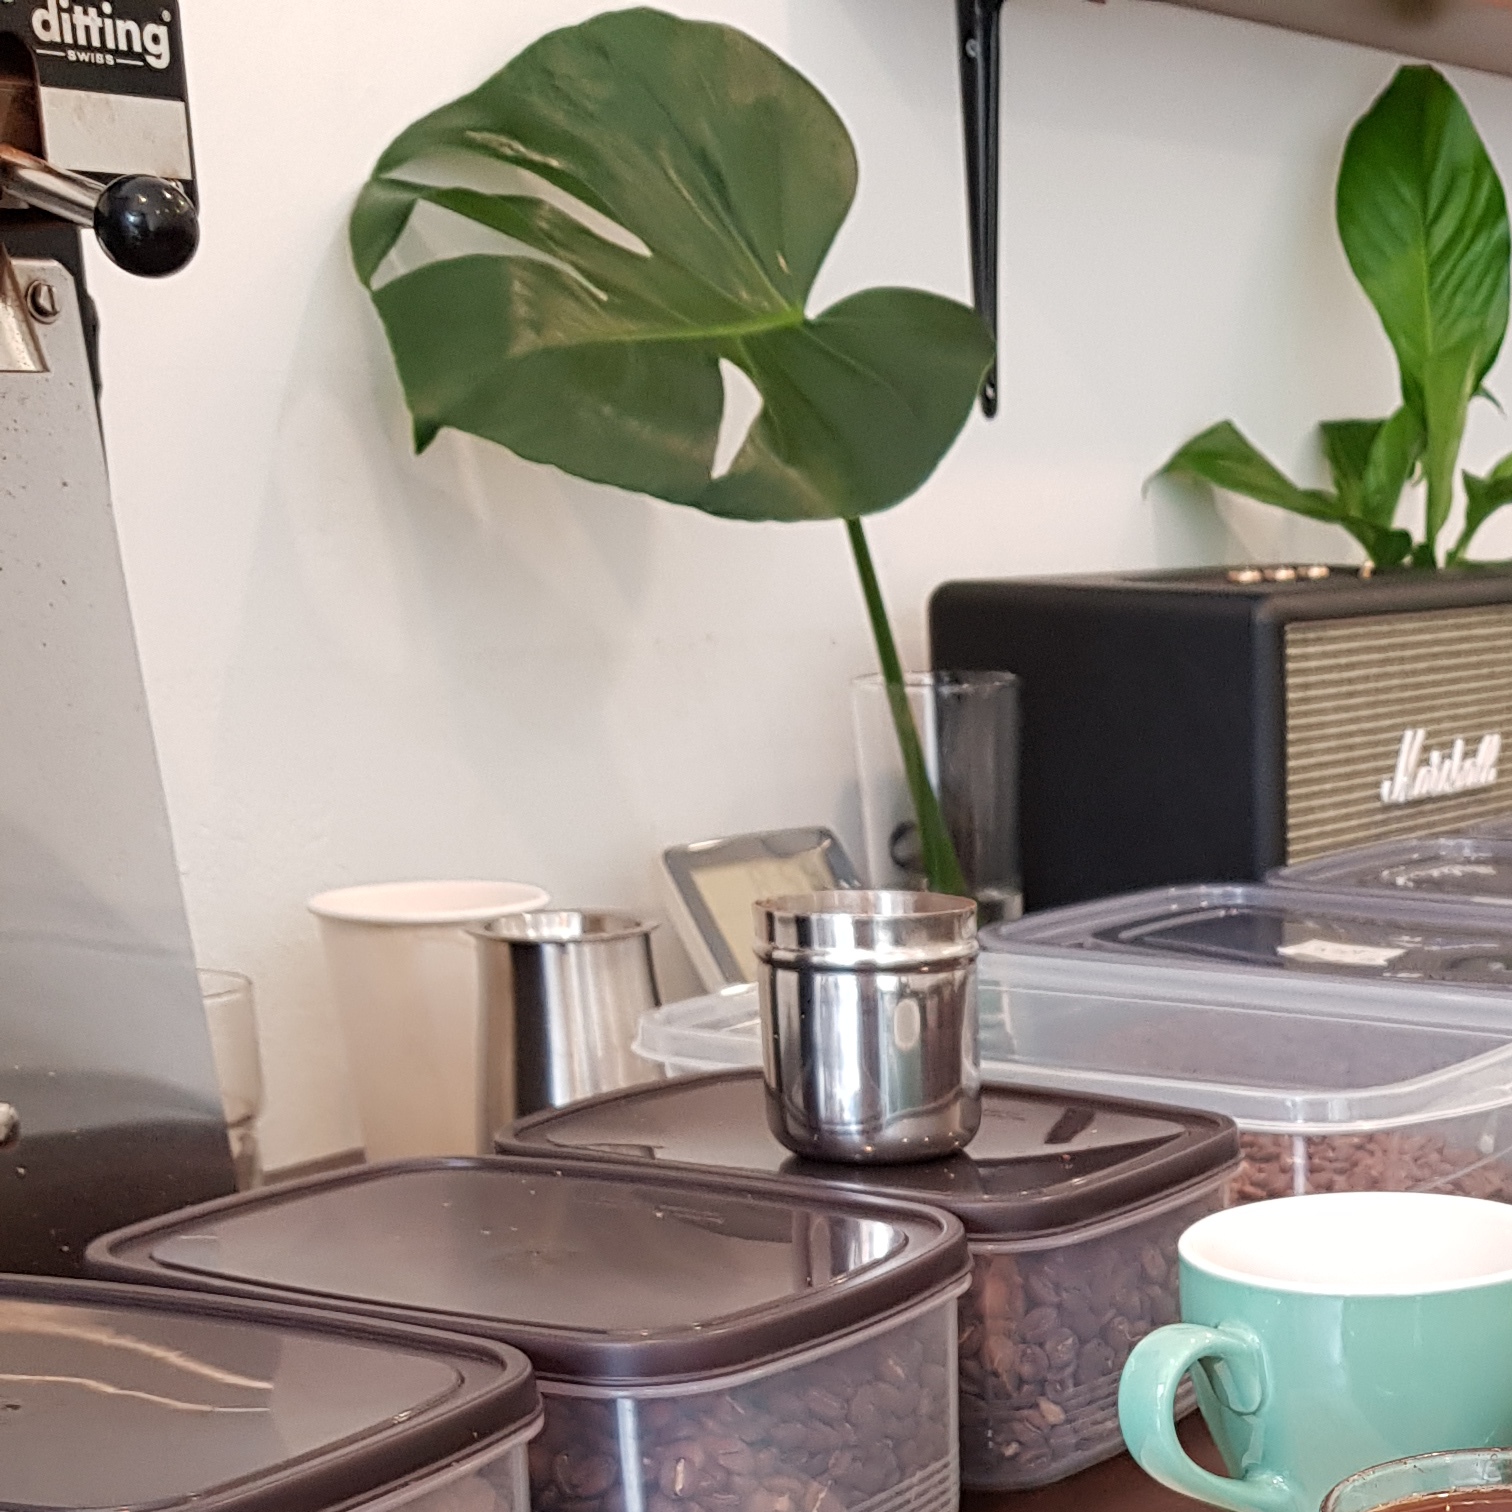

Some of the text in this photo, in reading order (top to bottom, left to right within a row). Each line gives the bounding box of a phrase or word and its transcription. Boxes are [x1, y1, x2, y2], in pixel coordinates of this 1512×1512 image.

[31, 0, 171, 69] ditting
[66, 50, 115, 65] SWISS
[1380, 728, 1502, 804] Marshall
